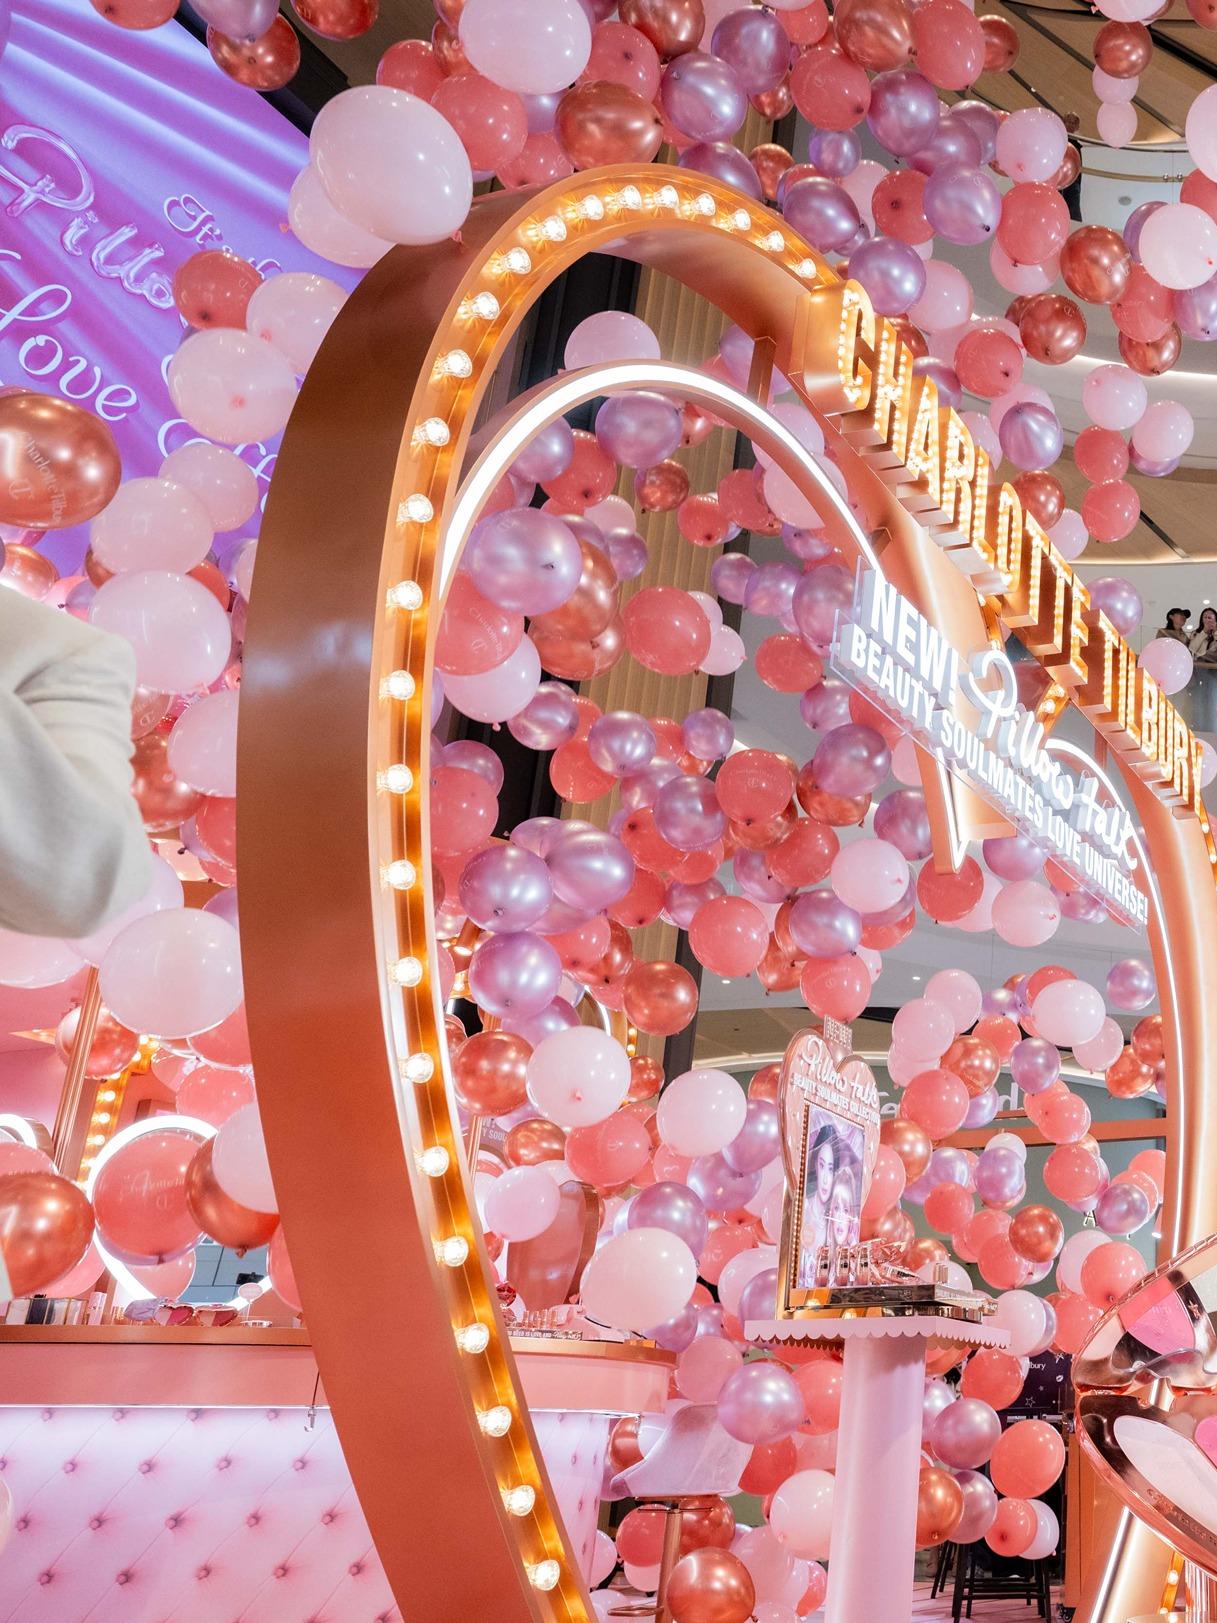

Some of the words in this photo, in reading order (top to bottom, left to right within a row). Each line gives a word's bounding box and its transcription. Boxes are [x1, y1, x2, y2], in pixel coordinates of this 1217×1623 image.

[0, 124, 186, 329] Pillo
[163, 193, 233, 255] It'
[835, 278, 1092, 686] CHARLOTTE
[1098, 606, 1204, 818] TILBURY
[851, 631, 936, 733] BEAUTY
[940, 713, 1044, 829] SOULMATES
[1047, 815, 1081, 864] LOVE
[1084, 845, 1149, 926] UNIVERSE!
[870, 575, 959, 710] NEW!
[969, 649, 1075, 808] Pillow
[792, 1073, 816, 1095] BEAUTY
[1028, 1361, 1046, 1371] lbury
